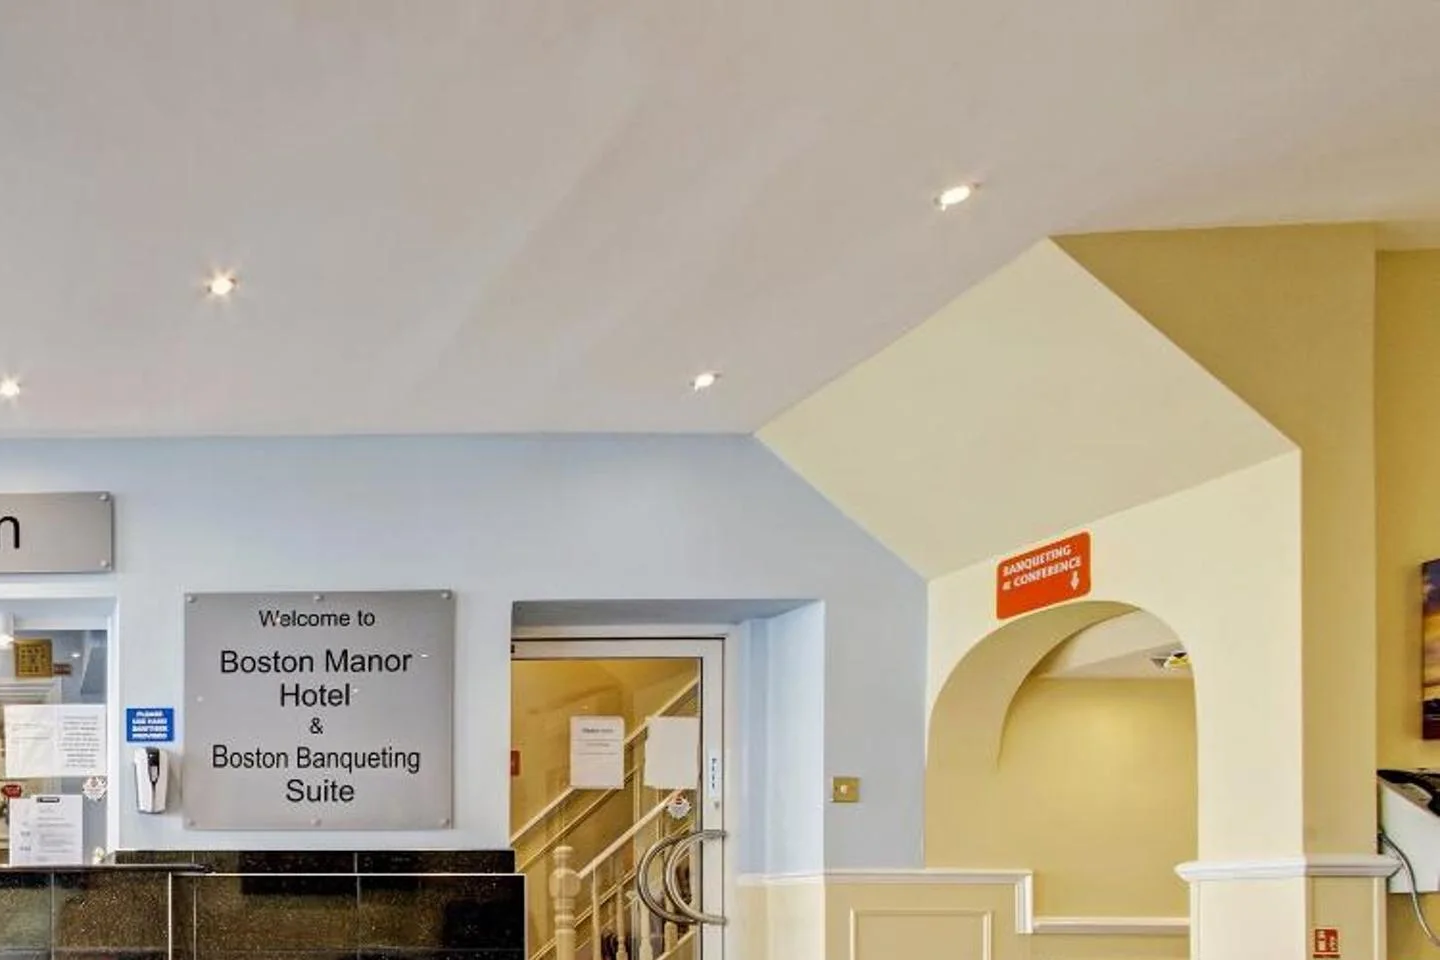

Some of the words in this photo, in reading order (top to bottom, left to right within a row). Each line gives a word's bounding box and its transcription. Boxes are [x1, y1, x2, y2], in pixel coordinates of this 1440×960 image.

[1002, 544, 1072, 577] BANQUETING
[1013, 555, 1081, 587] CONFERENCE
[259, 610, 350, 627] Welcome
[357, 610, 376, 627] to
[220, 650, 314, 674] Boston
[325, 649, 412, 672] Manor
[280, 683, 351, 706] Hotel
[310, 718, 324, 734] &
[212, 744, 288, 769] Boston
[297, 746, 421, 774] Banqueting
[286, 779, 355, 803] Suite
